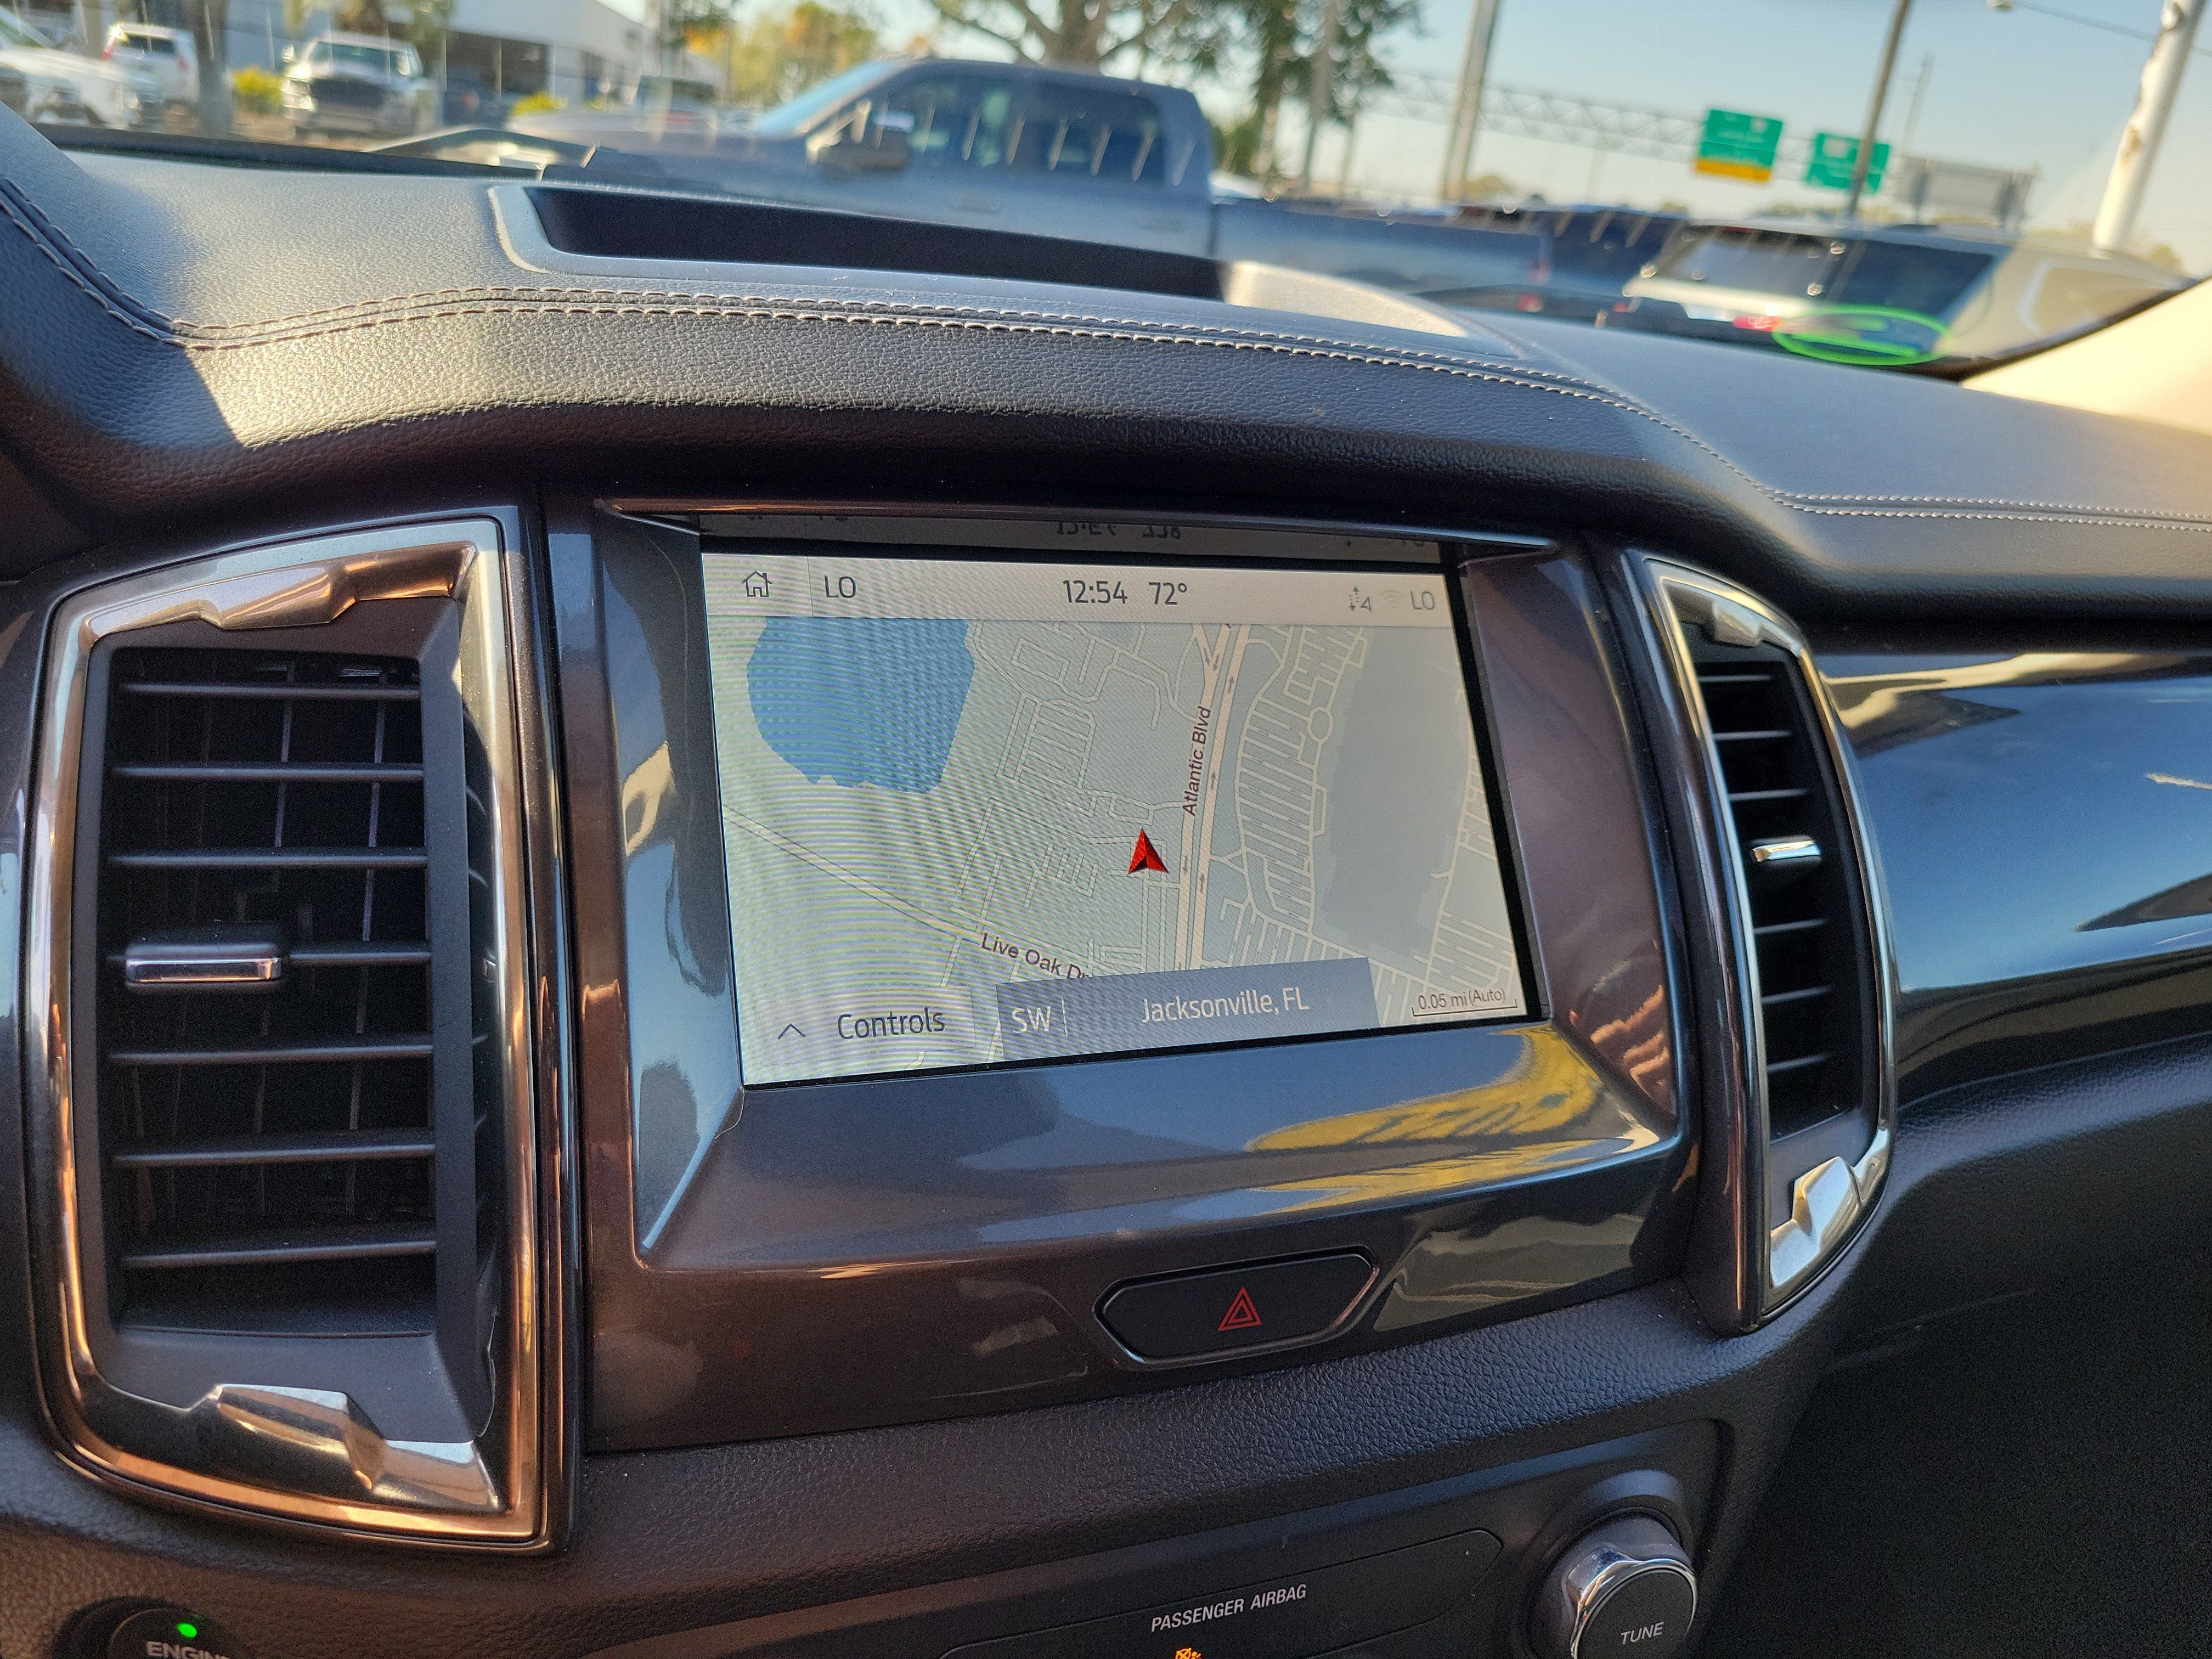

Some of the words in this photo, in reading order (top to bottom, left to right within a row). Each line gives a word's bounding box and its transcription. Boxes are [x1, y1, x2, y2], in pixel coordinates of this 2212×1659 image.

[824, 575, 856, 598] LO
[1063, 580, 1128, 604] 12:54
[1148, 582, 1187, 605] 72°
[1410, 590, 1436, 611] LO
[1192, 706, 1211, 744] Blvd
[1182, 749, 1204, 817] Atlantic
[981, 933, 1019, 958] Live
[1025, 949, 1060, 975] Oak
[1142, 989, 1279, 1023] Jacksonville,
[1282, 987, 1311, 1011] FL
[1418, 994, 1447, 1010] 0.05
[837, 1007, 945, 1040] Controls
[1012, 1006, 1052, 1034] SW
[1152, 1598, 1245, 1632] PASSENGER
[1250, 1584, 1307, 1610] AIRBAG
[1621, 1621, 1664, 1645] TUNE
[146, 1641, 230, 1659] ENGI
